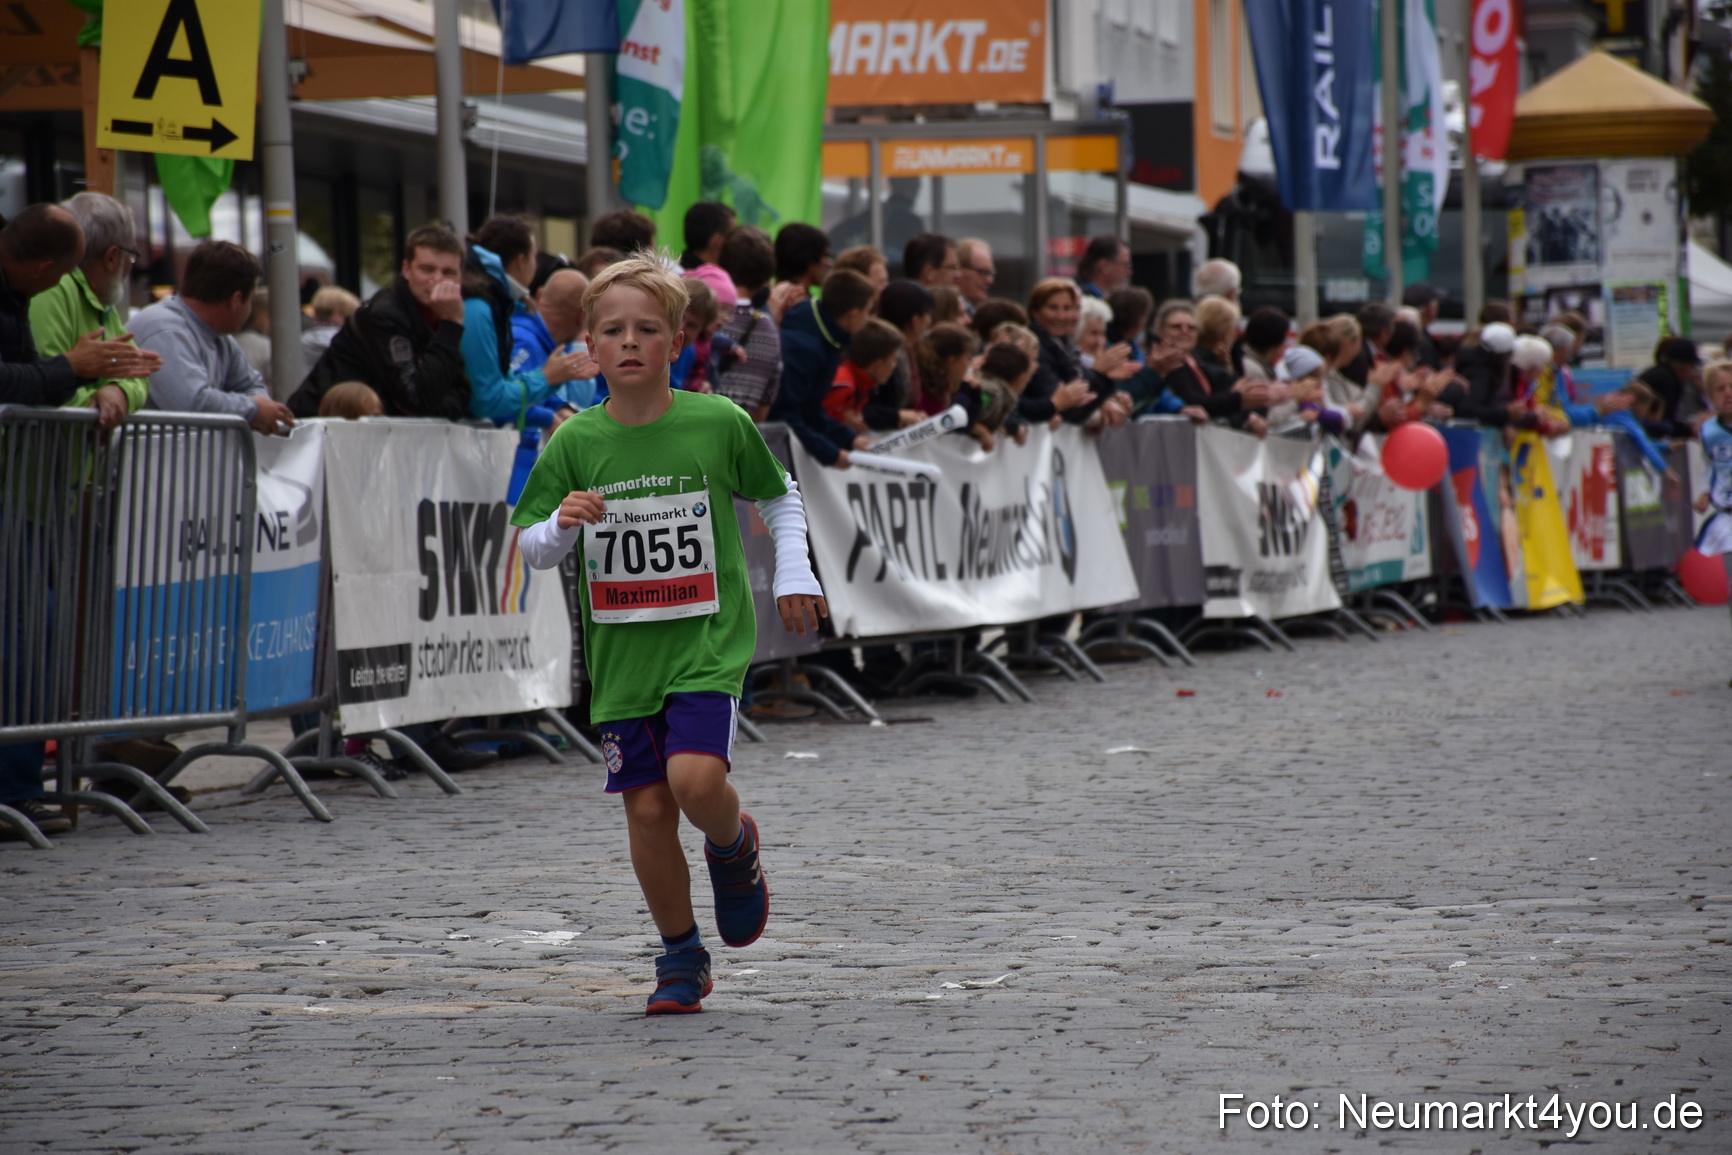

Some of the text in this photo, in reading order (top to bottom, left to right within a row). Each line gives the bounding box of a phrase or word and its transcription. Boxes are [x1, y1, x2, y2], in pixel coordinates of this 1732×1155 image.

[133, 0, 222, 107] A
[1313, 5, 1341, 170] RAIL
[587, 475, 673, 497] Neumarkter
[625, 507, 687, 523] Neumarkt
[595, 523, 702, 575] 7055
[605, 584, 698, 605] Maximilian
